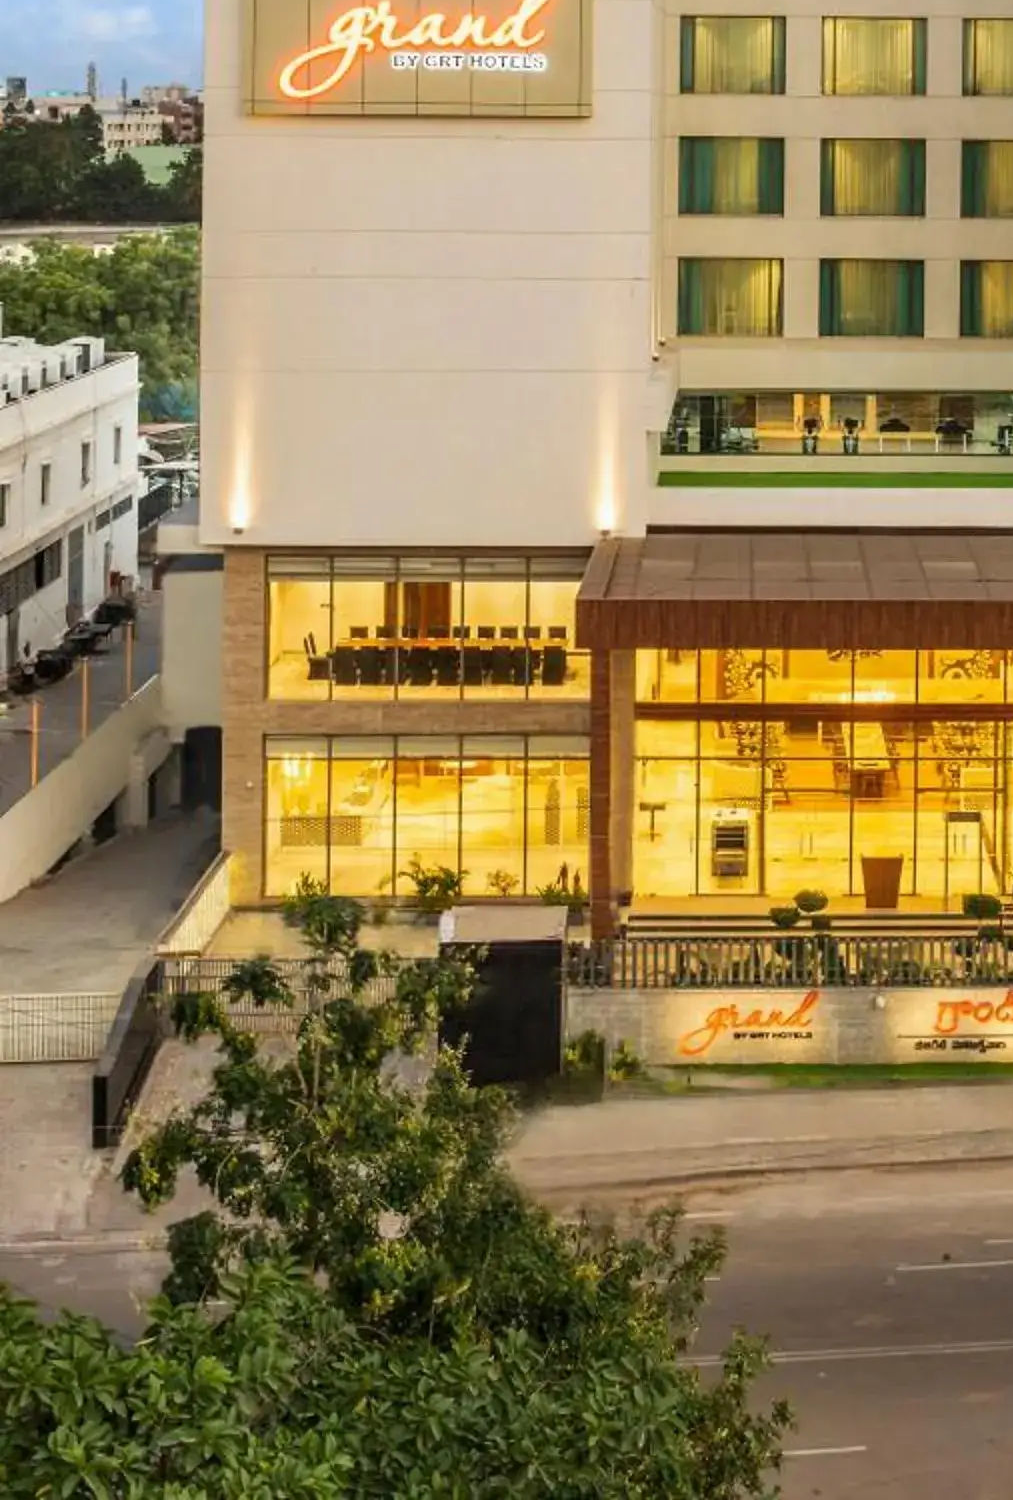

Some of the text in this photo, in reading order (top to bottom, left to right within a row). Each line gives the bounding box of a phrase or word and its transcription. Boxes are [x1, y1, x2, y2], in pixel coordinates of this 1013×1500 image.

[392, 53, 545, 69] BY GRT HOTELS
[681, 989, 819, 1055] grand
